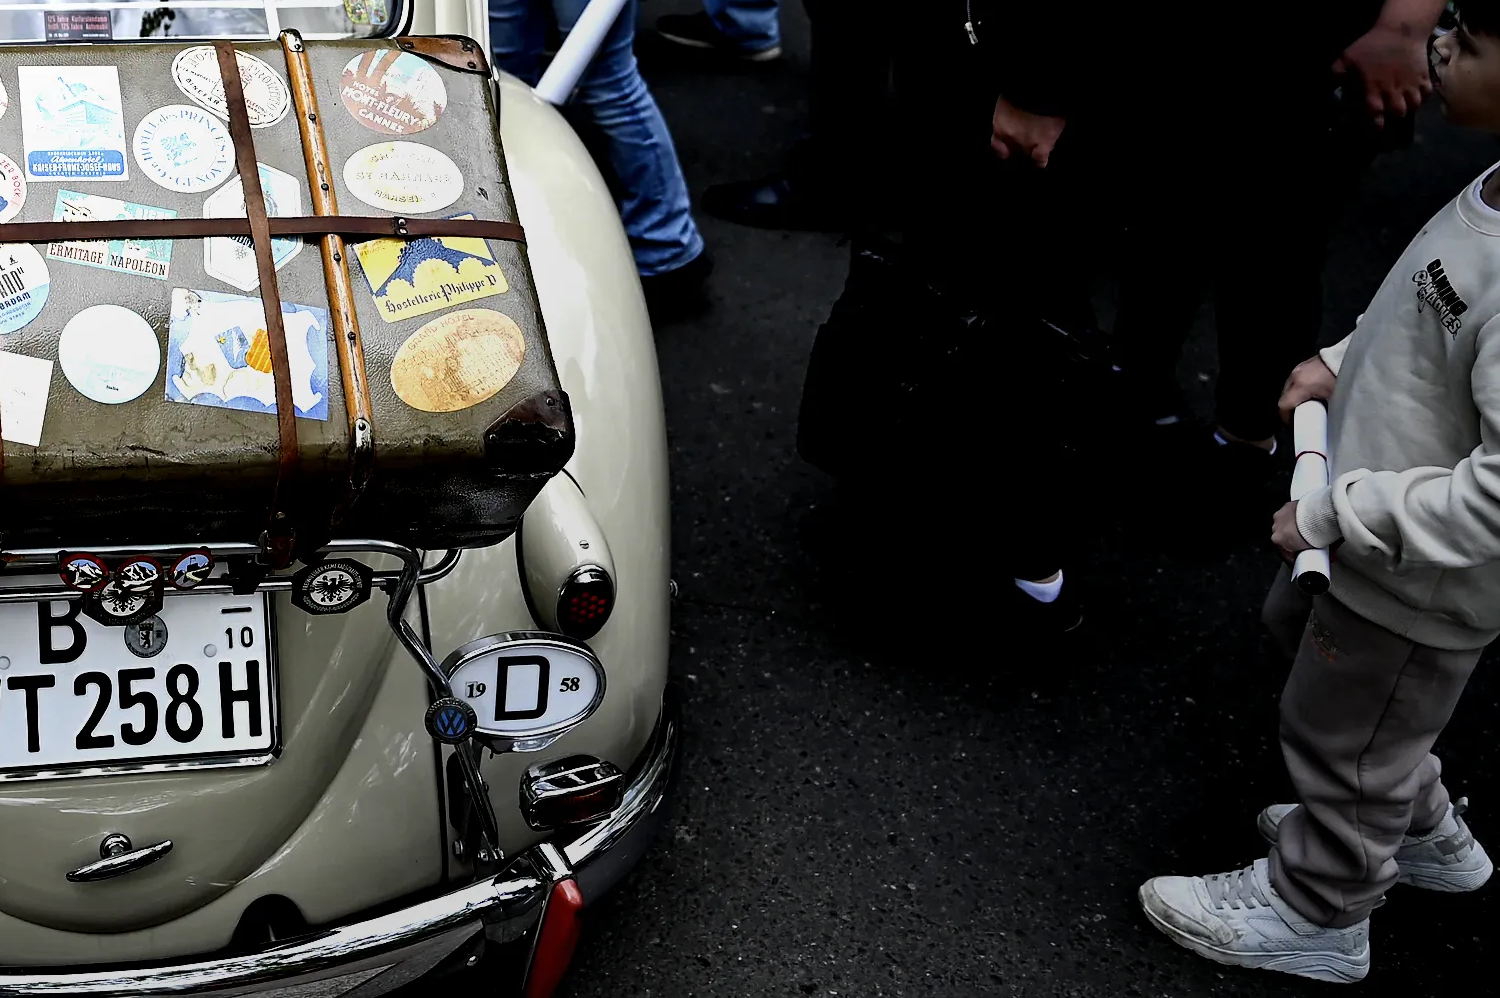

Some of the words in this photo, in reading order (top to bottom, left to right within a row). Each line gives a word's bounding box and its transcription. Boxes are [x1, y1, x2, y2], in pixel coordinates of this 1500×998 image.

[353, 81, 380, 97] HOTEL
[359, 108, 405, 133] CANNES
[49, 243, 104, 265] ERMITAGE
[439, 314, 475, 328] HOTEL
[37, 600, 88, 665] B
[224, 626, 255, 649] 10
[466, 682, 487, 699] 19
[494, 655, 551, 722] D
[559, 676, 581, 693] 58
[73, 663, 204, 751] 258
[218, 659, 263, 739] H
